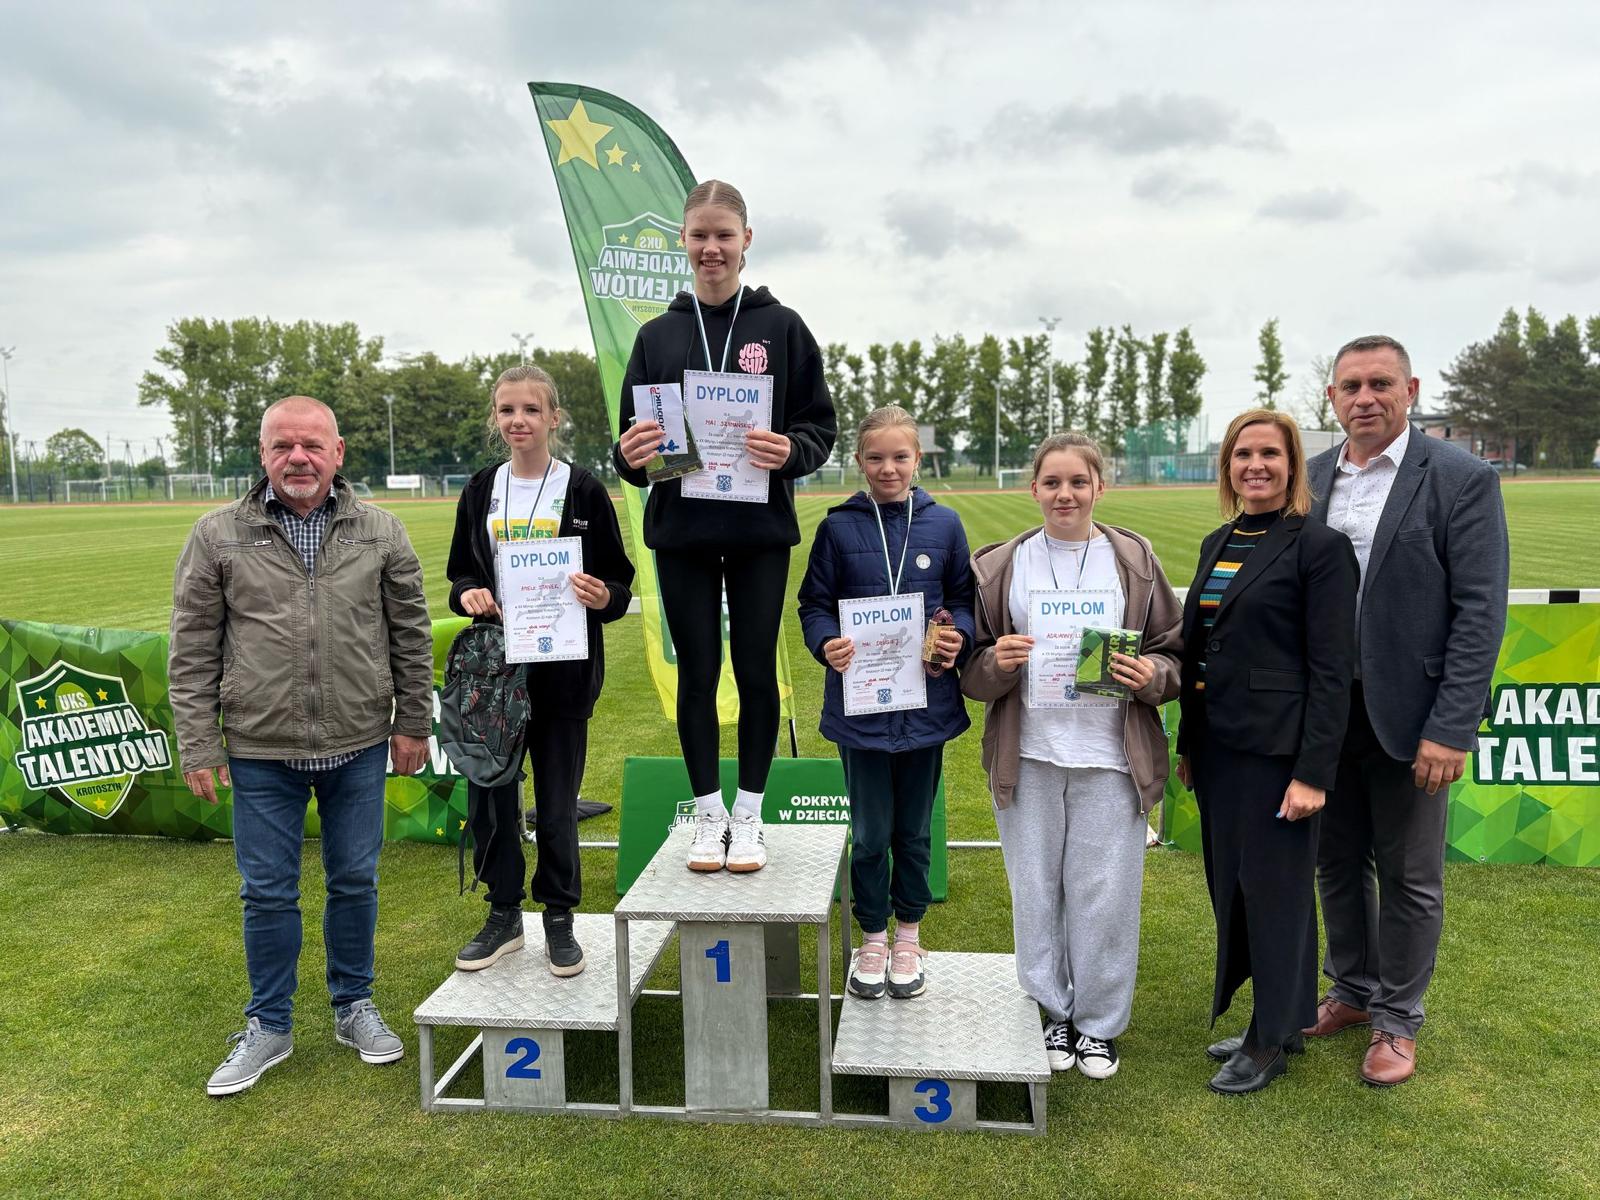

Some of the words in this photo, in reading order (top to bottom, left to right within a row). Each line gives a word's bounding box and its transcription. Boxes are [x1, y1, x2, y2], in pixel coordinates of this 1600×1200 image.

[739, 342, 768, 359] JUST
[738, 356, 769, 374] CHILL
[696, 385, 759, 404] DYPLOM
[511, 551, 569, 568] DYPLOM
[852, 607, 912, 625] DYPLOM
[1041, 601, 1104, 615] DYPLOM
[58, 692, 88, 711] UKS
[27, 708, 142, 748] AKADEMIA
[20, 732, 167, 785] TALENTÓW
[1478, 737, 1600, 781] TALE
[76, 782, 122, 797] KROTOSZYN
[779, 810, 792, 820] W
[796, 810, 851, 820] DZIECIA
[705, 940, 731, 982] 1
[505, 1037, 541, 1079] 2
[914, 1079, 953, 1123] 3
